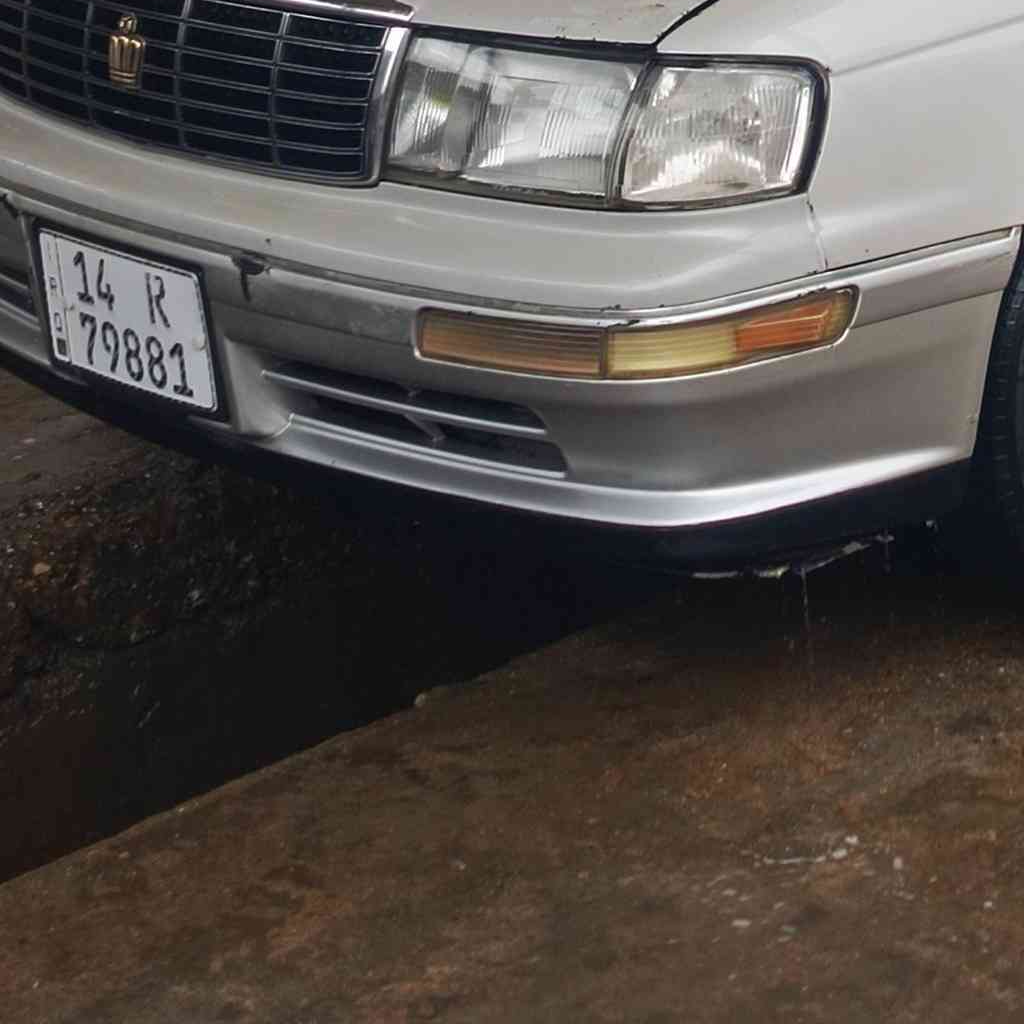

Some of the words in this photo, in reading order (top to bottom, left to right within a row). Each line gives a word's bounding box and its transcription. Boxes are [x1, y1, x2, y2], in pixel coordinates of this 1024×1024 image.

[73, 250, 116, 312] 14
[145, 273, 171, 329] R
[79, 311, 194, 398] 79881
